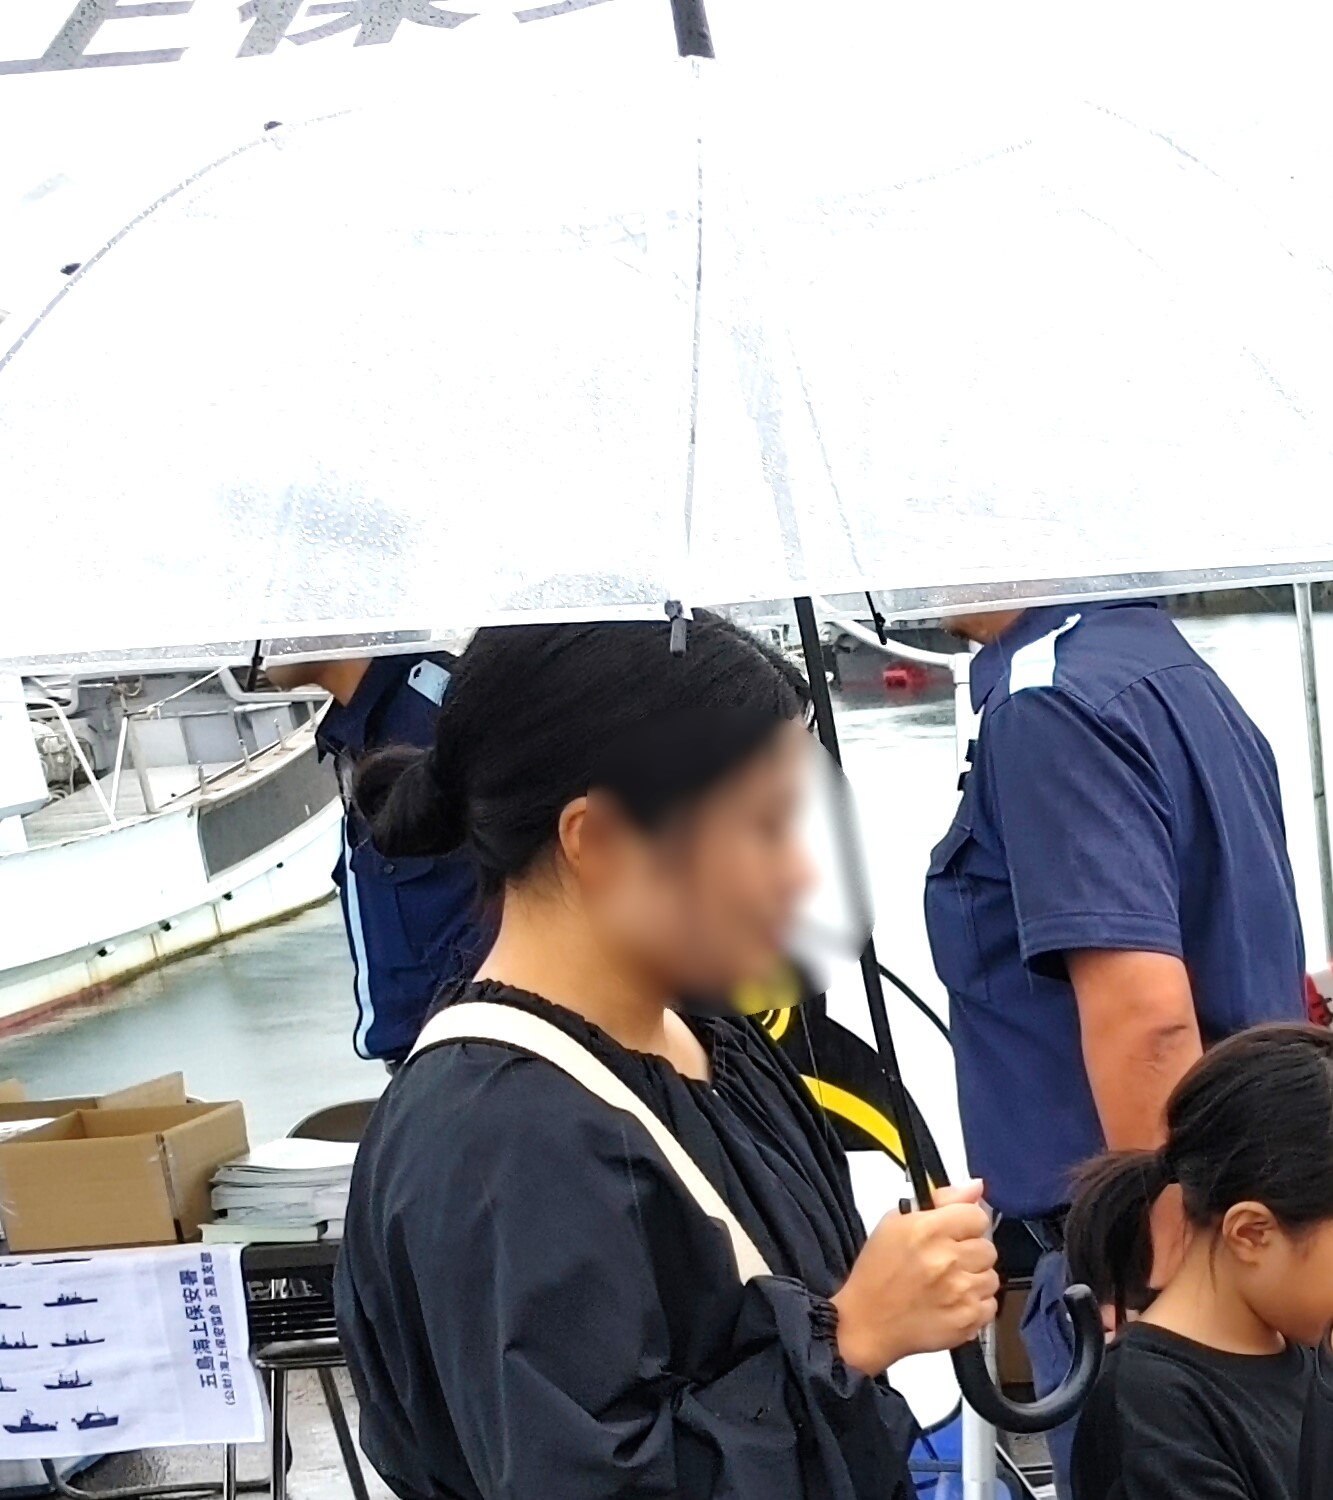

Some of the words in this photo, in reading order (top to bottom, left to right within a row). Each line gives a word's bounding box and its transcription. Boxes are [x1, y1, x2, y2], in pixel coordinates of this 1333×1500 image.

[179, 1269, 218, 1389] 五島海上保安署
